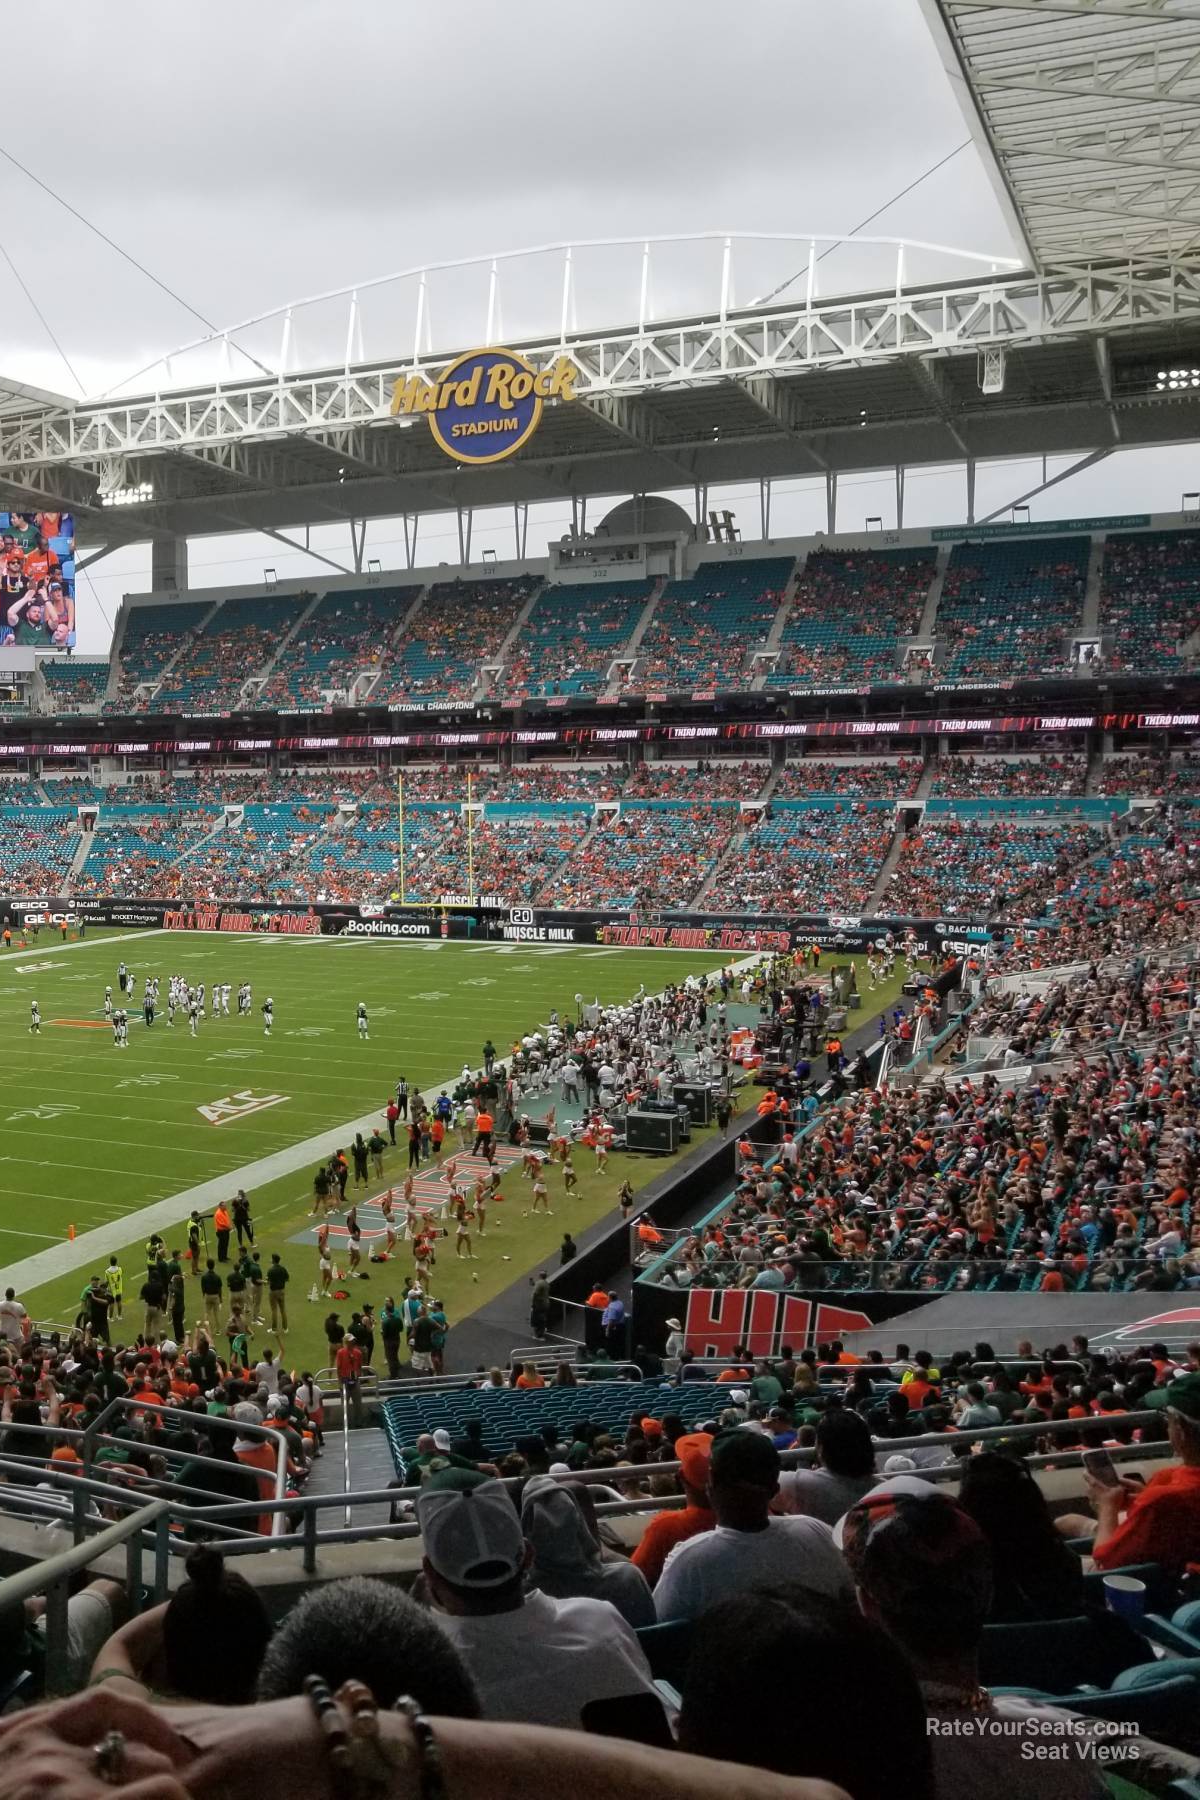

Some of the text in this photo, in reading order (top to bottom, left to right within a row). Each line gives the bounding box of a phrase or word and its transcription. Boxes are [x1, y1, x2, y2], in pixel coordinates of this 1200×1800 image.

[391, 356, 578, 416] Hard Rock
[451, 418, 518, 438] STADIUM
[388, 701, 475, 713] NATIONAL CHAMPIONS
[941, 720, 992, 730] THIRD DOWN
[1040, 718, 1093, 728] THIRD DOWN
[1144, 714, 1199, 726] THIRD DOWN
[674, 727, 718, 737] THIRD DOWN
[761, 724, 807, 734] THIRD DOWN
[852, 722, 900, 732] THIRD DOWN
[440, 734, 479, 743] THIRD DOWN
[516, 732, 556, 741] THIRD DOWN
[596, 729, 638, 739] THIRD DOWN
[178, 741, 211, 750] THIRD DOWN
[238, 740, 271, 748] THIRD DOWN
[303, 738, 339, 747] THIRD DOWN
[372, 736, 409, 745] THIRD DOWN
[8, 746, 25, 754] DOWN
[53, 745, 87, 753] THIRD DOWN
[117, 743, 149, 751] THIRD DOWN
[10, 901, 49, 910] GEICO
[513, 909, 530, 923] 20
[348, 920, 430, 935] Booking.com
[503, 926, 575, 940] MUSCLE MILK
[196, 1088, 282, 1124] ACC
